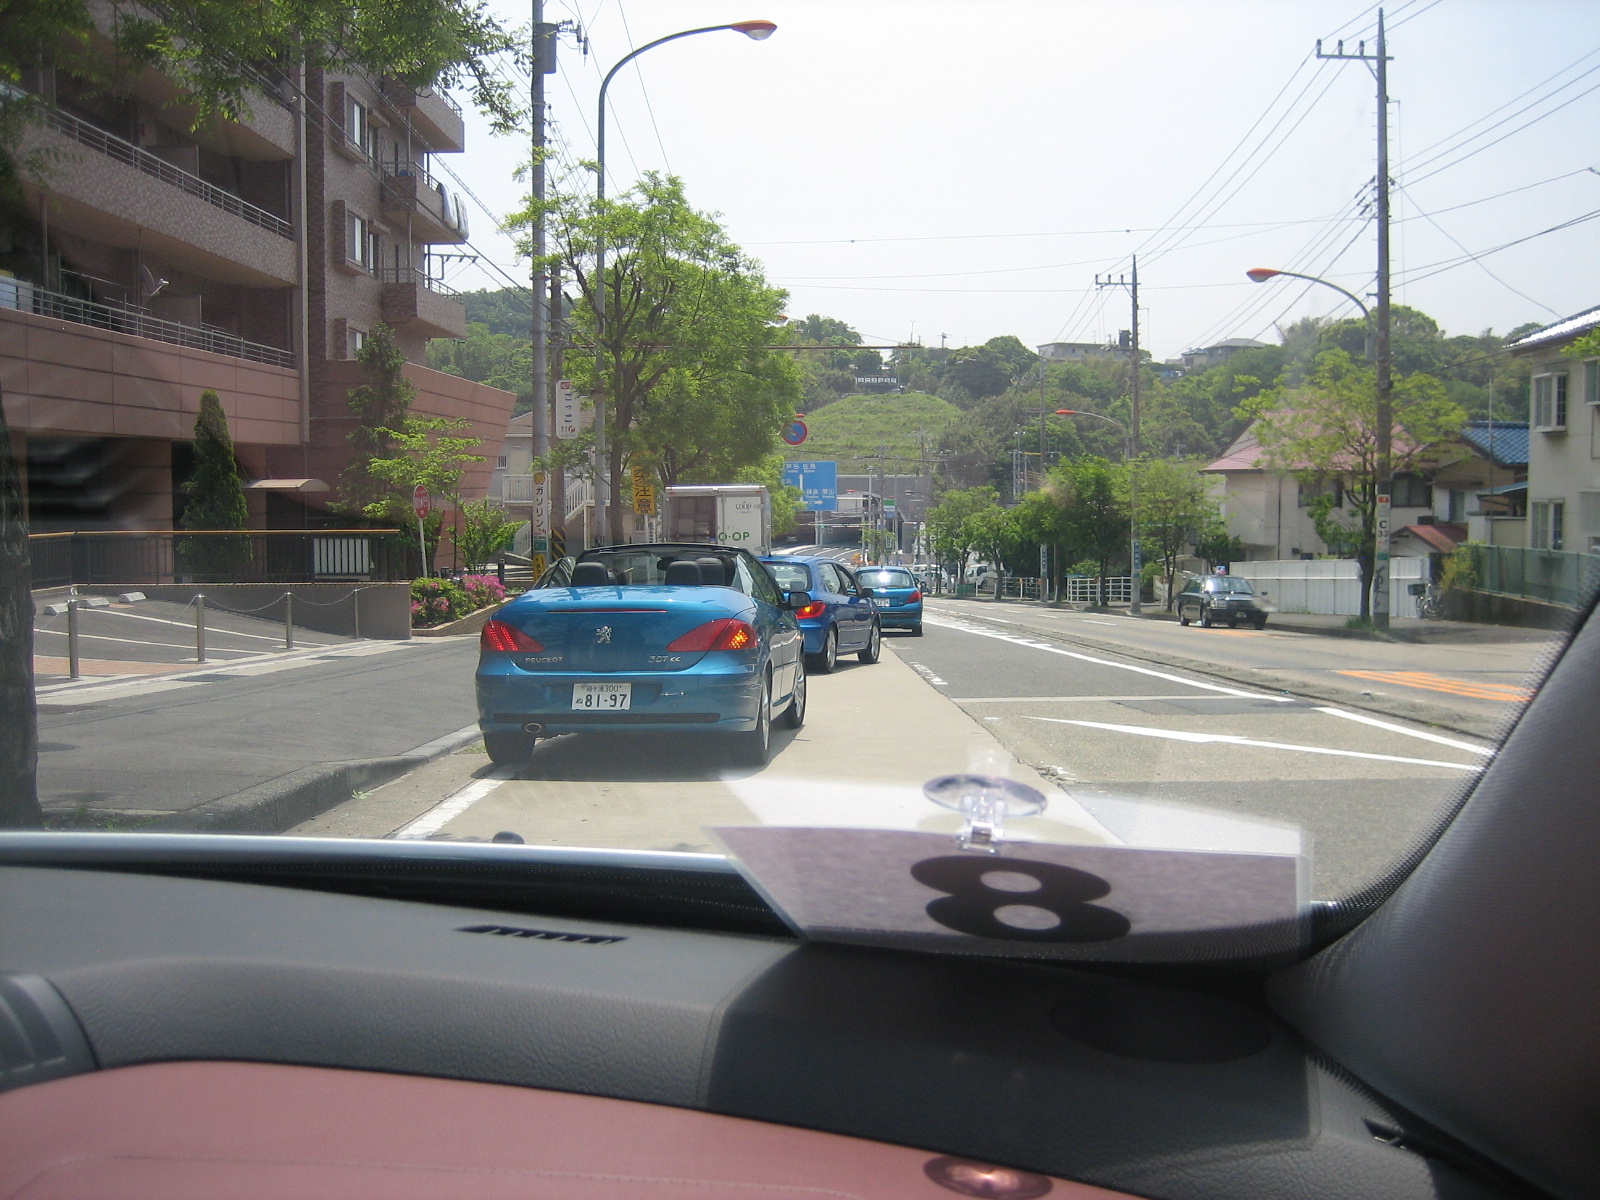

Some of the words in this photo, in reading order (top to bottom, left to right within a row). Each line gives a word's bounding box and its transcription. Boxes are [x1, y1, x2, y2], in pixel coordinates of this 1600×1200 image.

[536, 486, 544, 528] ガソリン
[585, 694, 628, 708] 81-97
[910, 855, 1131, 942] 8
